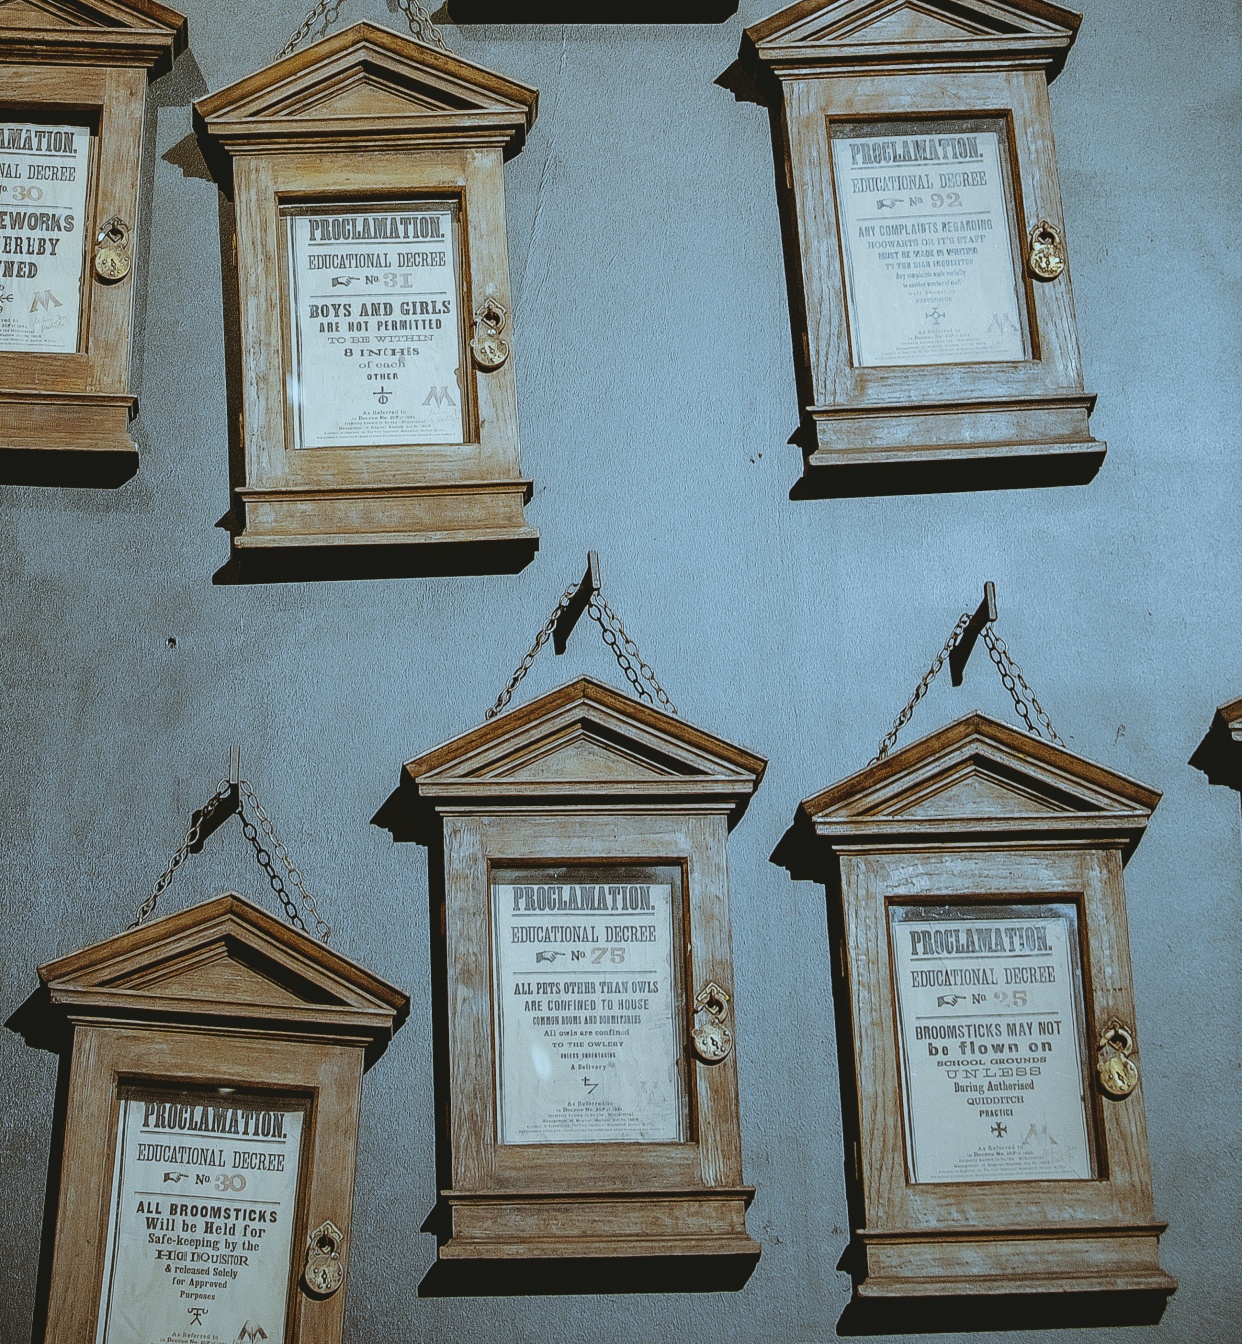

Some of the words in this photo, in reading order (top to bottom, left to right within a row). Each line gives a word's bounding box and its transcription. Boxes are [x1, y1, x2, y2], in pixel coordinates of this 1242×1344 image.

[850, 136, 984, 165] PROCLAMATION.
[28, 164, 76, 182] DECREE
[852, 174, 934, 194] EDUCATIONAL
[939, 171, 988, 189] DECREE
[12, 185, 43, 202] 30
[309, 216, 445, 241] PROCLAMATION.
[858, 226, 876, 238] ANY
[880, 222, 938, 236] COMPLAINTS
[942, 219, 993, 233] REGARDING
[308, 253, 392, 270] EDUCATIONAL
[397, 252, 446, 268] DECREE
[309, 304, 352, 318] BOYS
[359, 302, 393, 317] AND
[400, 300, 450, 315] GIRLS
[319, 322, 340, 333] ARE
[348, 321, 369, 332] NOT
[377, 318, 442, 331] PERMITTED
[350, 336, 370, 344] BE
[373, 334, 434, 343] WITHIN
[344, 348, 353, 357] 8
[359, 348, 420, 357] INCHES
[367, 373, 398, 381] OTHER
[512, 886, 656, 911] PROCLAMATION.
[511, 926, 599, 943] EDUCATIONAL
[605, 925, 656, 942] DECREE
[910, 926, 1052, 956] PROCLAMATION.
[591, 947, 625, 964] 75
[911, 968, 998, 988] EDUCATIONAL
[1004, 966, 1056, 985] DECREE
[514, 982, 532, 995] ALL
[536, 982, 561, 995] PETS
[563, 982, 596, 994] OTHER
[599, 982, 628, 994] THAN
[631, 982, 659, 994] OWLS
[524, 1000, 543, 1012] ARE
[547, 999, 597, 1011] CONFINED
[601, 999, 614, 1011] TO
[618, 999, 649, 1010] HOUSE
[915, 1024, 1002, 1040] BROOMSTICKS
[1007, 1022, 1033, 1037] MAY
[1038, 1021, 1062, 1036] NOT
[928, 1042, 948, 1056] be
[959, 1040, 1019, 1055] flown
[1029, 1041, 1052, 1053] on
[990, 1057, 1047, 1065] GROUNDS
[946, 1067, 1042, 1079] UNLESS
[954, 1082, 984, 1094] During
[987, 1080, 1035, 1092] Authorised
[967, 1095, 1024, 1106] QUIDDITCH
[142, 1102, 288, 1139] PROCLAMATION.
[136, 1143, 226, 1168] EDUCATIONAL
[233, 1150, 285, 1172] DECREE
[214, 1174, 247, 1192] 30
[136, 1201, 162, 1215] ALL
[170, 1204, 278, 1223] BROOMSTICKS
[145, 1217, 175, 1232] Will
[182, 1218, 197, 1233] be
[204, 1221, 236, 1236] Held
[243, 1222, 266, 1238] for
[148, 1233, 220, 1252] Safe-keeping
[224, 1238, 237, 1252] by
[242, 1238, 260, 1252] the
[165, 1264, 172, 1272] &
[174, 1264, 210, 1276] released
[213, 1267, 238, 1279] Solely
